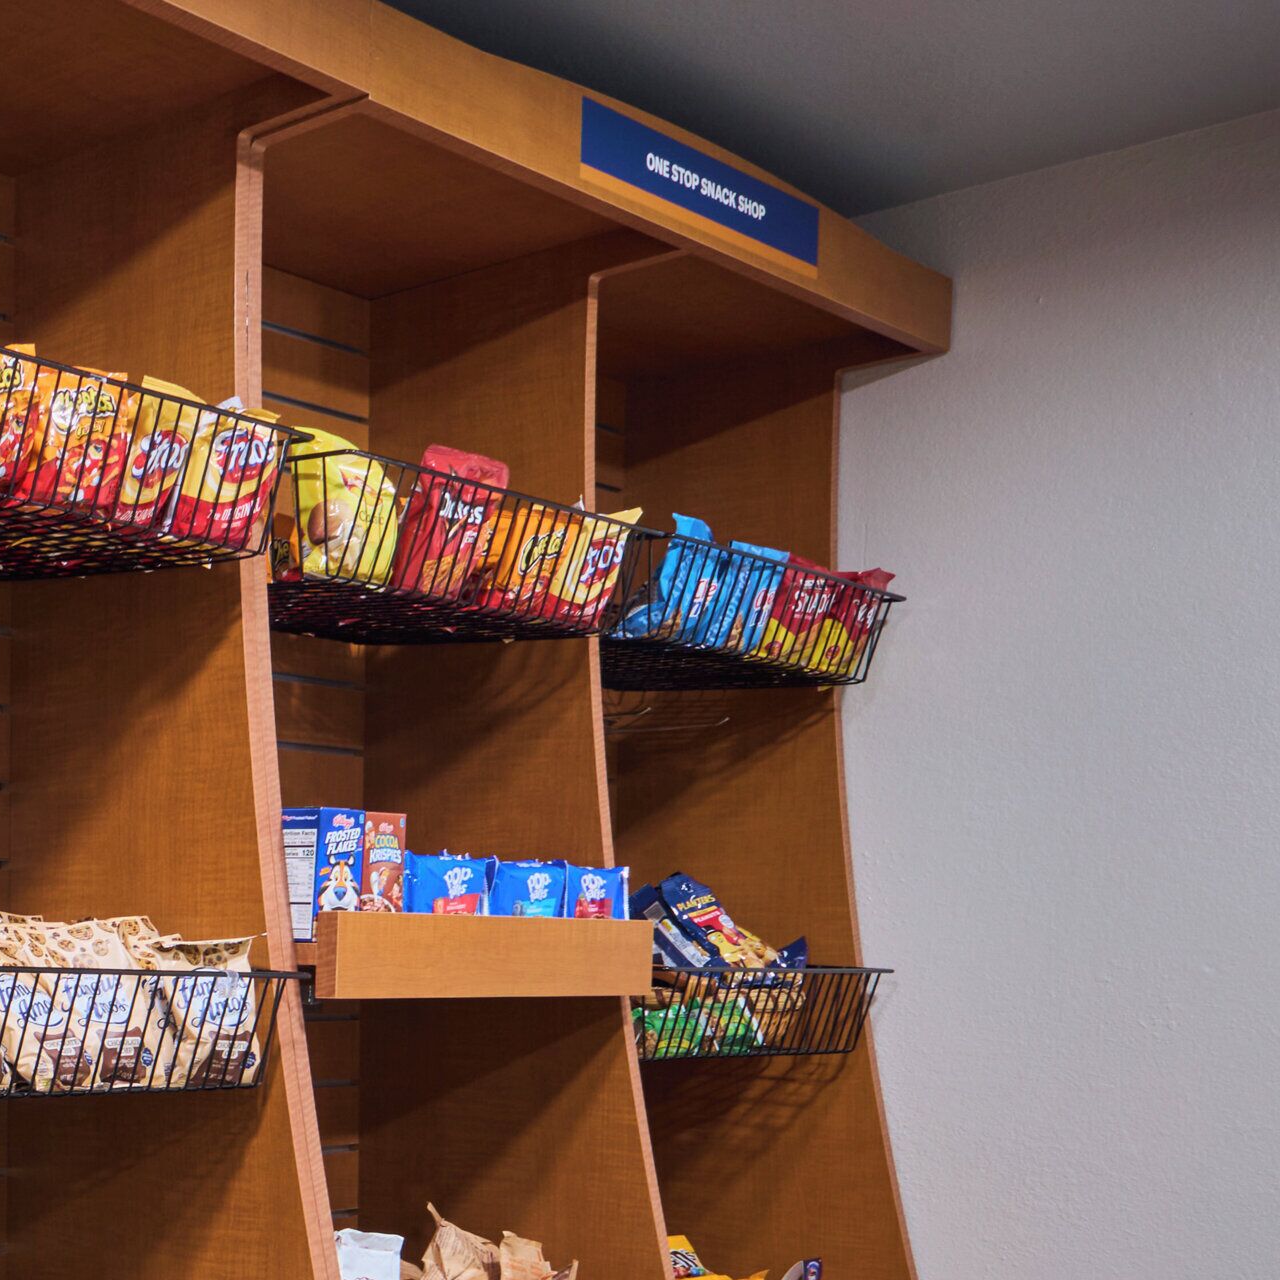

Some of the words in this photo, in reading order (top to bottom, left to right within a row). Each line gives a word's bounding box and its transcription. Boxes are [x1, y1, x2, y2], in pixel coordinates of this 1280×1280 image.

[646, 152, 670, 178] ONE
[671, 164, 699, 190] STOP
[700, 178, 737, 209] SNACK
[737, 195, 766, 220] SHOP
[325, 828, 361, 844] FROSTED
[375, 834, 399, 849] COCOA
[326, 840, 358, 855] FLAKES
[369, 848, 401, 864] KRISPIES
